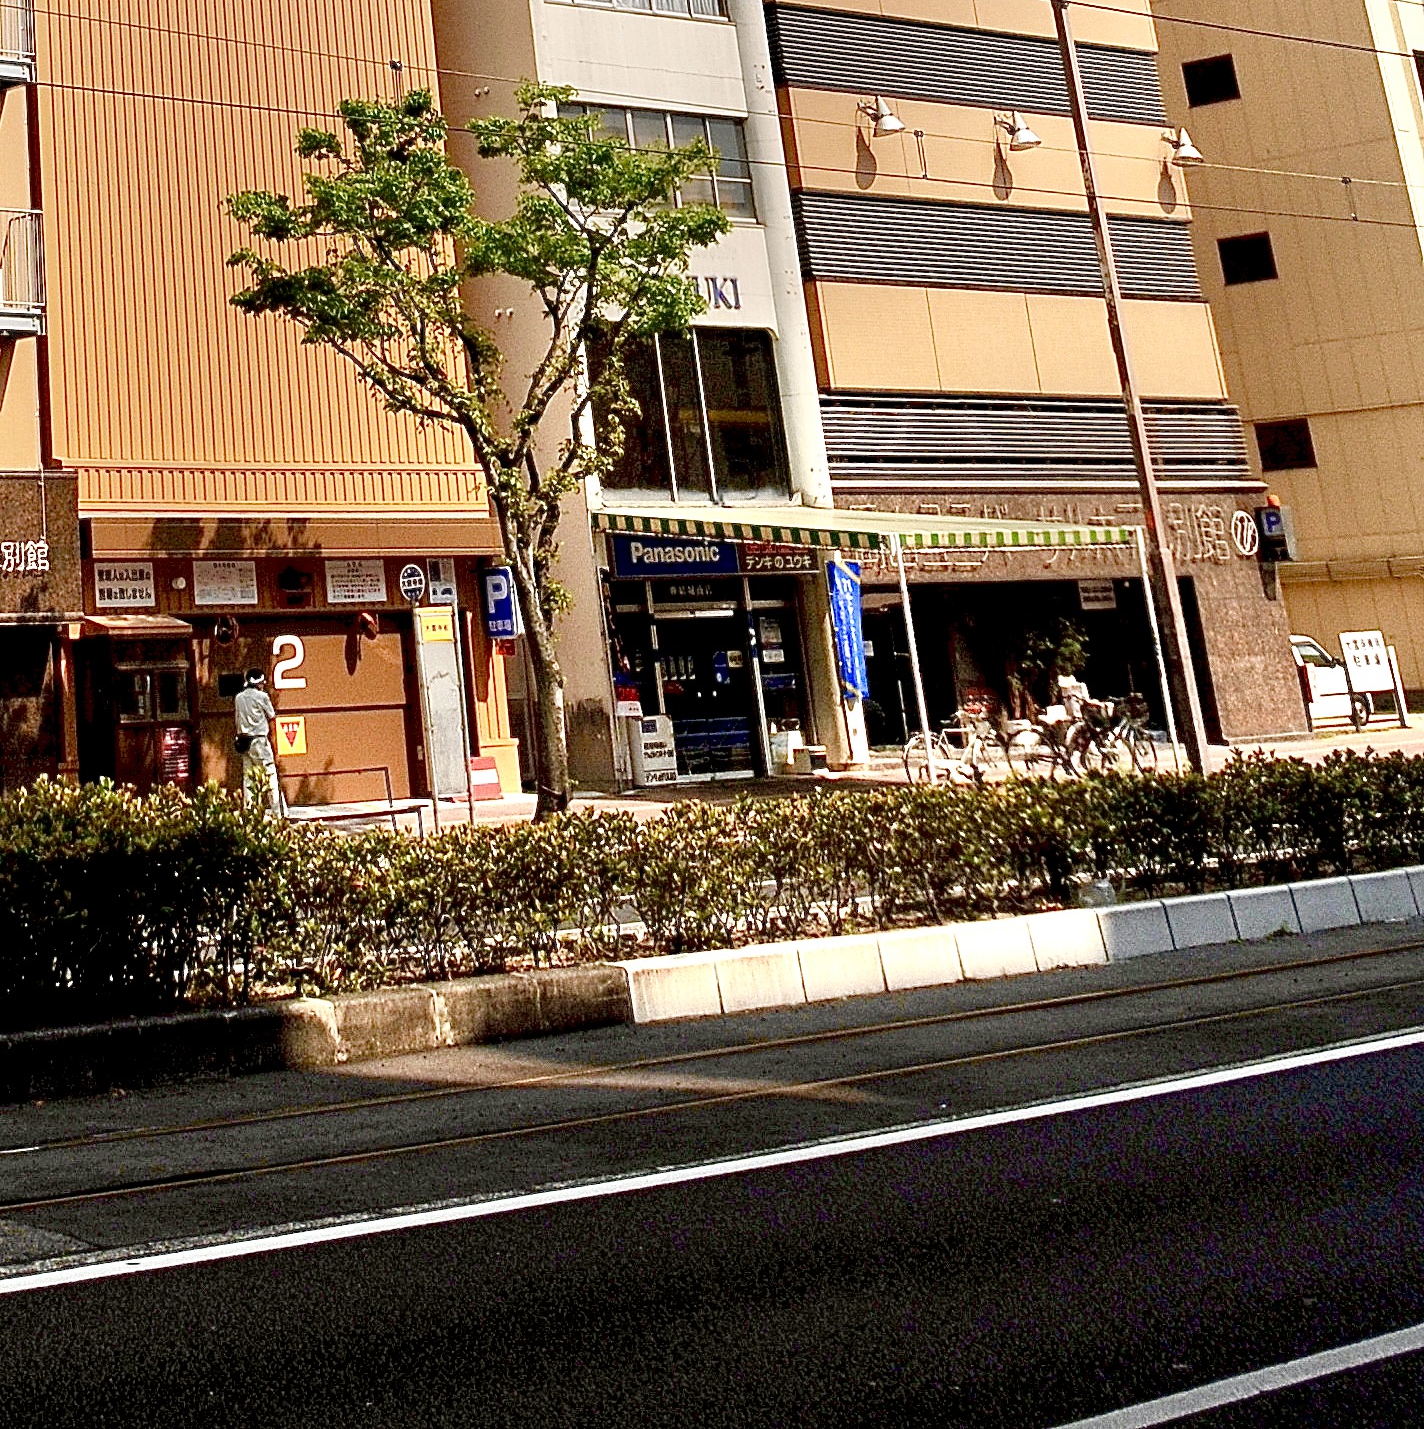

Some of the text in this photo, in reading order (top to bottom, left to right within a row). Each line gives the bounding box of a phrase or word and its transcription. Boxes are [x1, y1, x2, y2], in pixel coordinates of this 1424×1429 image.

[1265, 511, 1281, 533] P
[630, 540, 720, 564] Panasonic
[486, 575, 508, 614] P
[272, 634, 307, 689] 2
